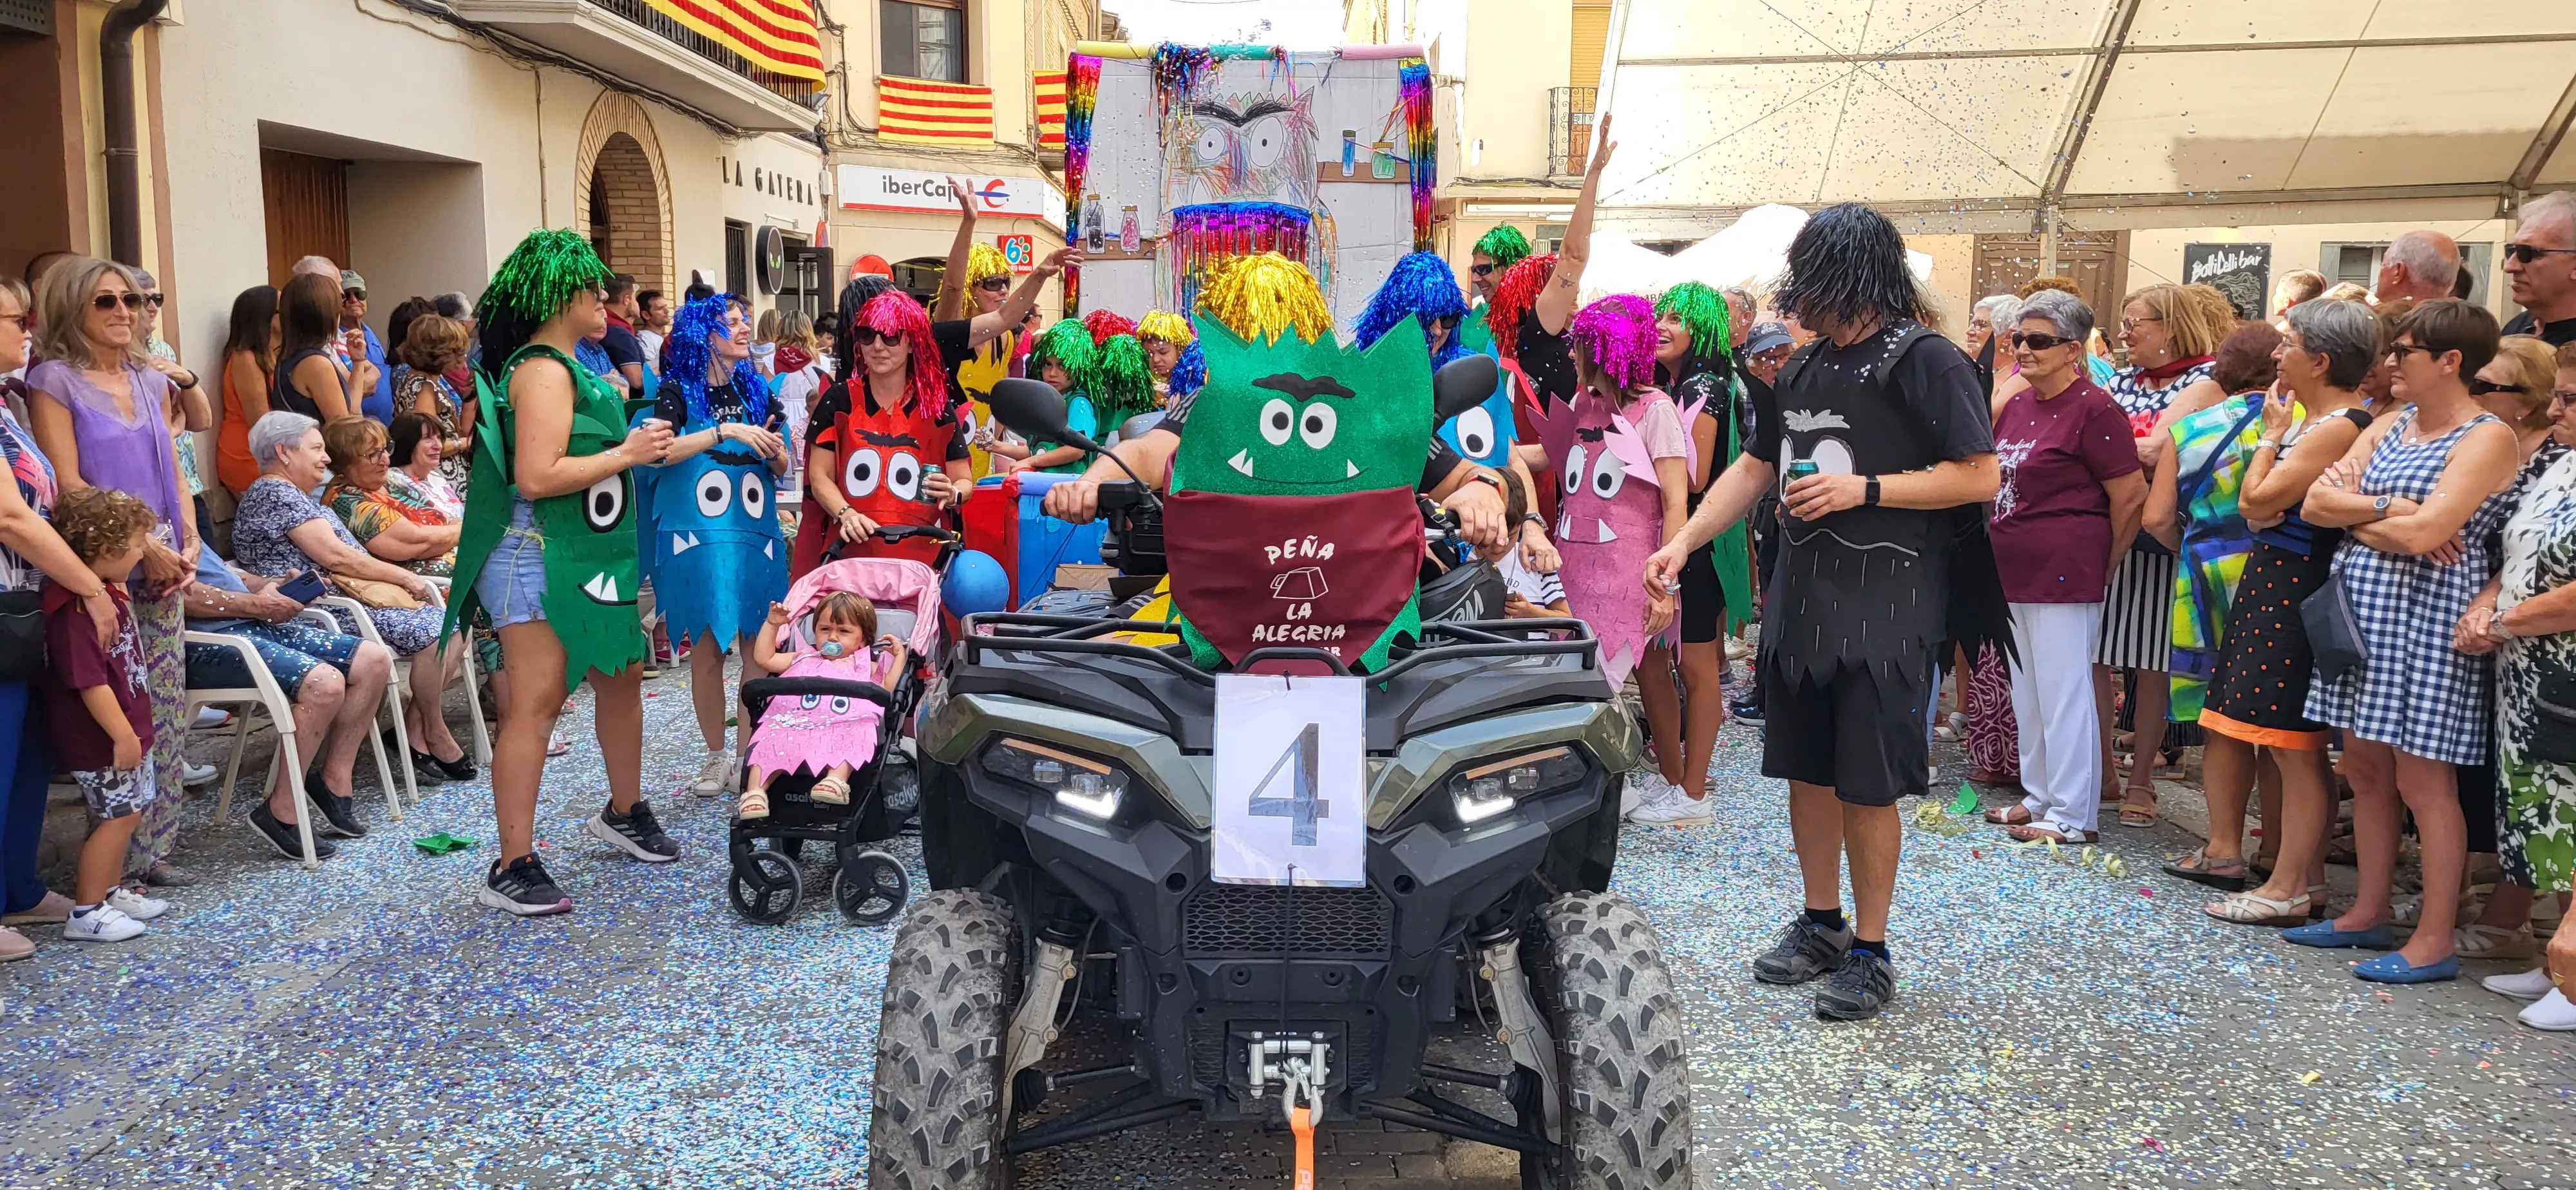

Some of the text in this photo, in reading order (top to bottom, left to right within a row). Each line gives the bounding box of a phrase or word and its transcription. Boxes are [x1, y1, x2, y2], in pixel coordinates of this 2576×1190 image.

[722, 156, 813, 206] LA GATERA
[882, 175, 959, 203] iberCaj
[2239, 250, 2262, 269] bar
[1264, 535, 1335, 565] PEÑA
[1287, 603, 1312, 620] LA
[1252, 624, 1345, 643] ALEGRIA
[887, 784, 918, 808] asalvo
[1248, 722, 1329, 846] 4
